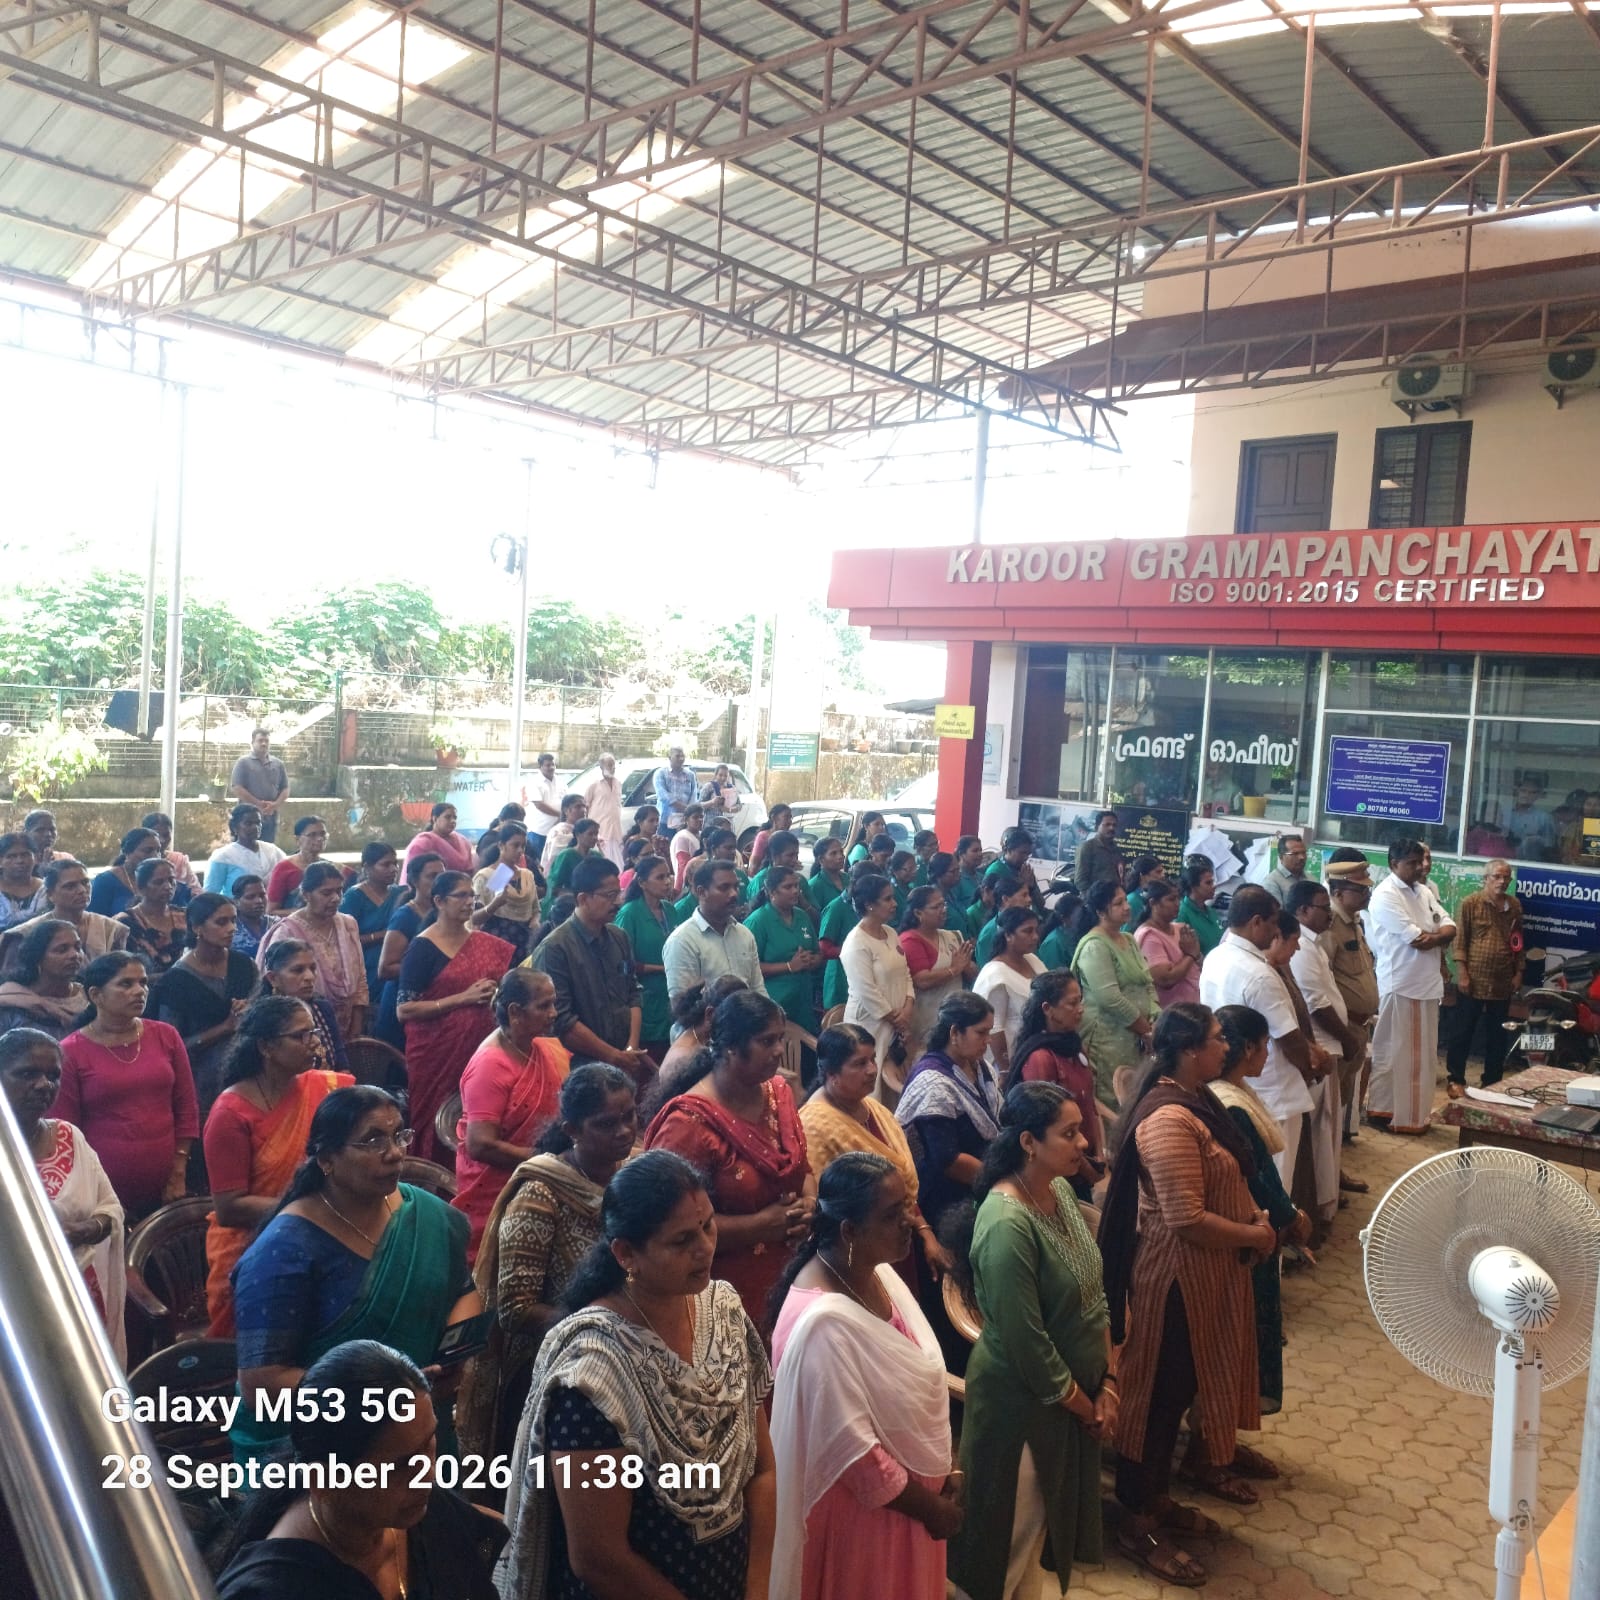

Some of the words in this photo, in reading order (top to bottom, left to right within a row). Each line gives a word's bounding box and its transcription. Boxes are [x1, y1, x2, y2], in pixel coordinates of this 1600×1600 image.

[946, 543, 1107, 583] KAROOR
[1130, 528, 1600, 580] GRAMAPANCHAYAT
[1169, 583, 1214, 604] ISO
[1226, 580, 1360, 604] 9001:2015
[1373, 577, 1545, 603] CERTIFIED
[1114, 733, 1195, 762] ഫ്രണ്ട്
[1209, 734, 1299, 767] ഓഫീസ്
[453, 781, 486, 792] WATER
